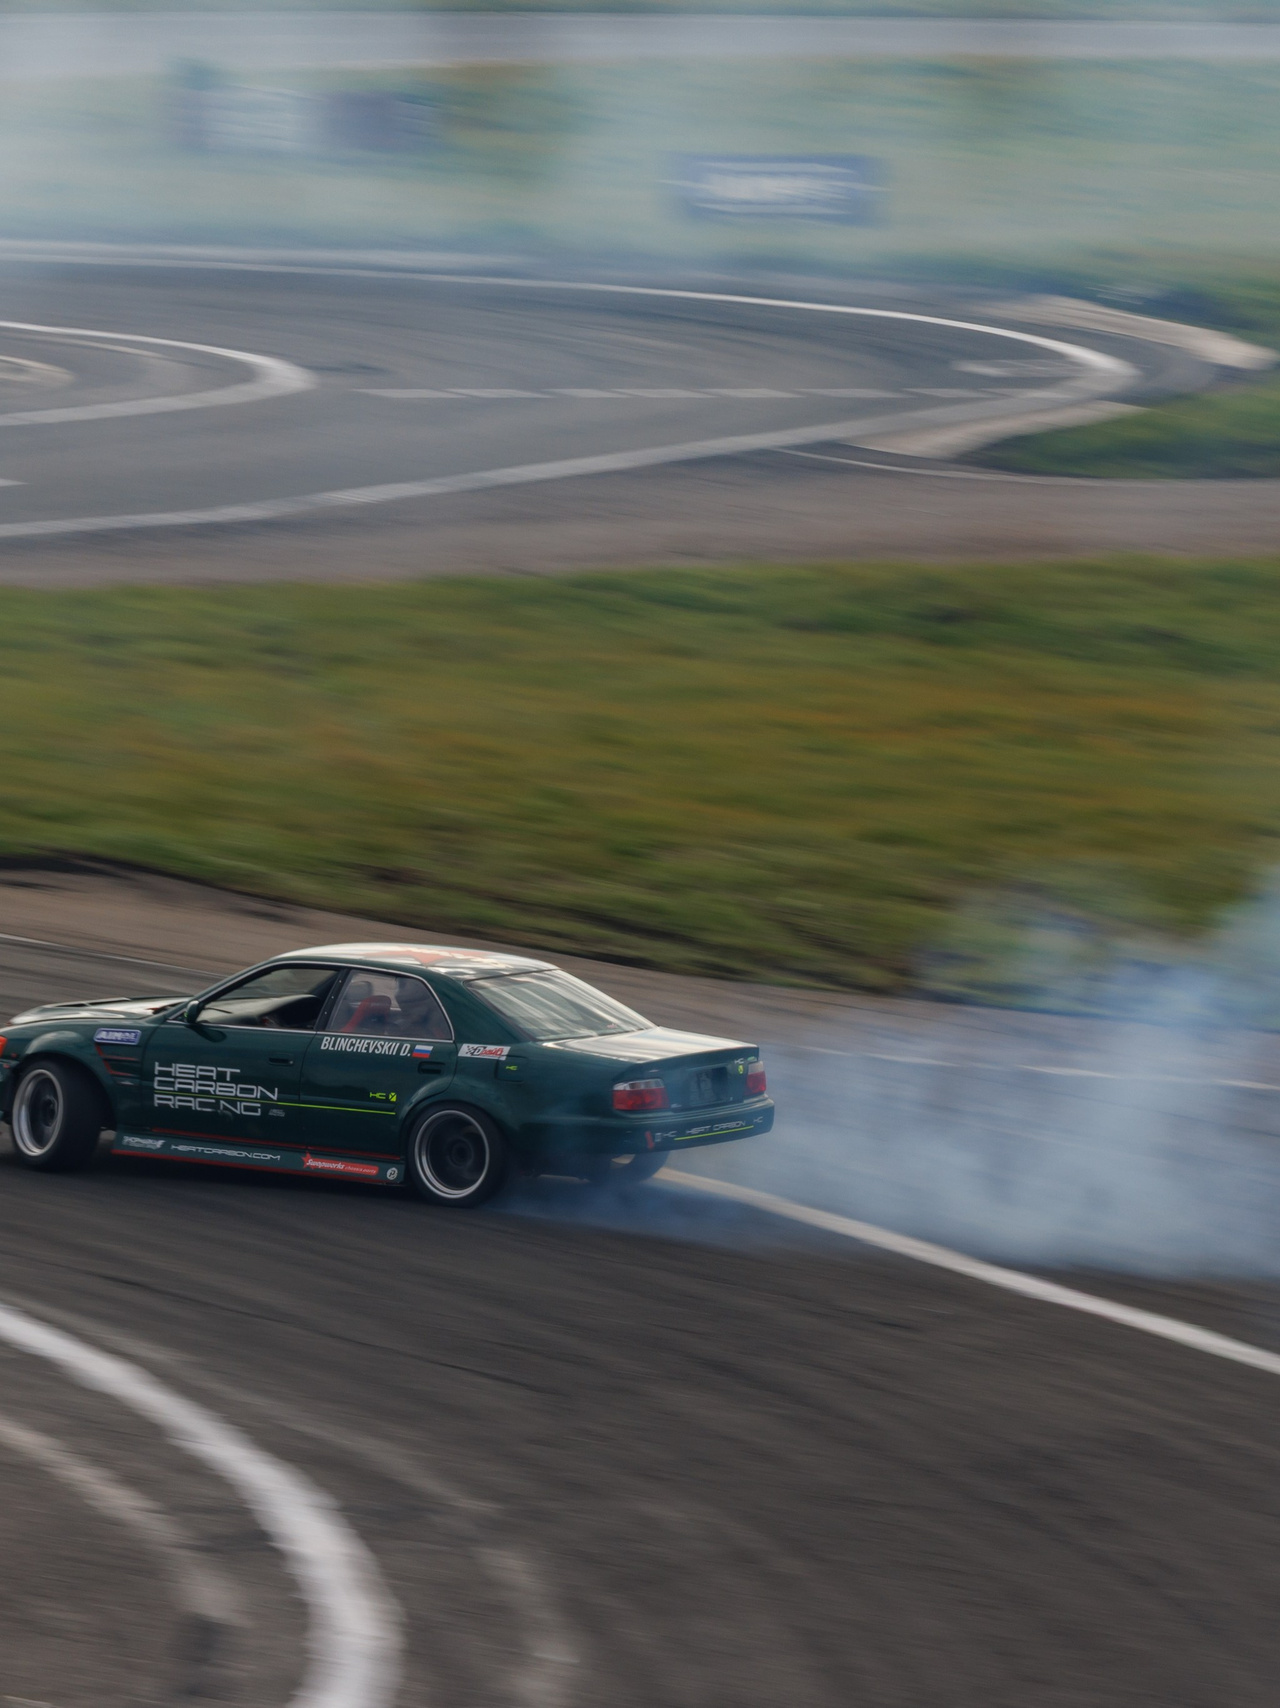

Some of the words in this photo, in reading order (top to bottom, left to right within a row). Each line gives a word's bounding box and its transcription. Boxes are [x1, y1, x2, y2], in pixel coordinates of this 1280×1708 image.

[320, 1036, 399, 1056] BLINCHEVSKII
[400, 1043, 411, 1057] D.
[154, 1061, 241, 1081] HEAT
[154, 1076, 278, 1101] CARBON
[171, 1144, 280, 1161] HEATCARBON.COM
